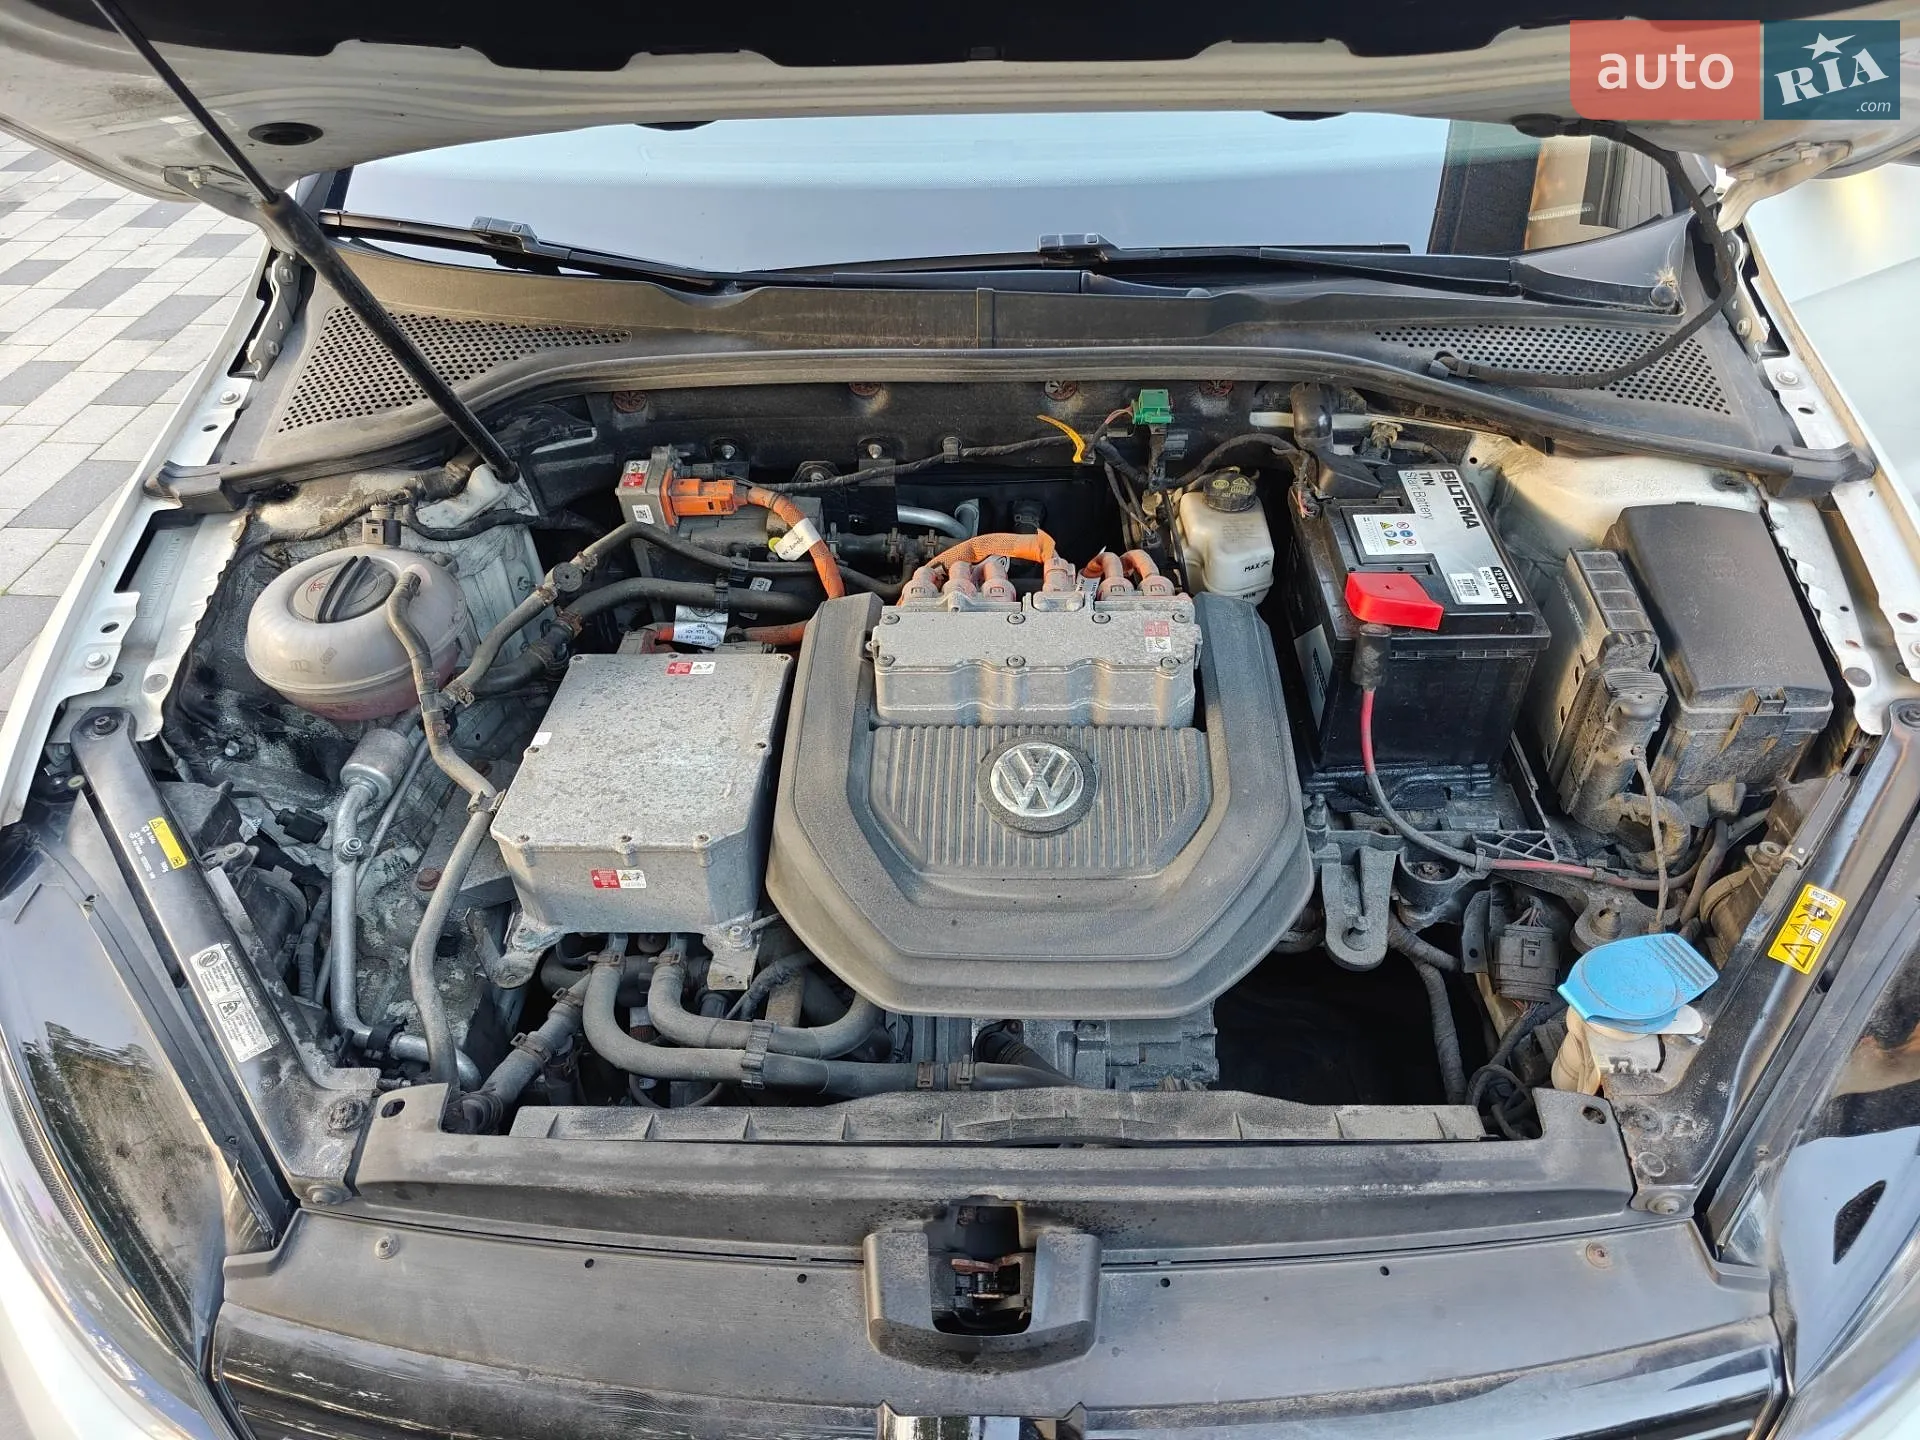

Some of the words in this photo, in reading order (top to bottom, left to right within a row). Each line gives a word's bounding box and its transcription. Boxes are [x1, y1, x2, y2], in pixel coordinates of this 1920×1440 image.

[1413, 491, 1434, 521] Battery
[1440, 471, 1480, 529] BILTEMA
[1244, 563, 1260, 572] MAX
